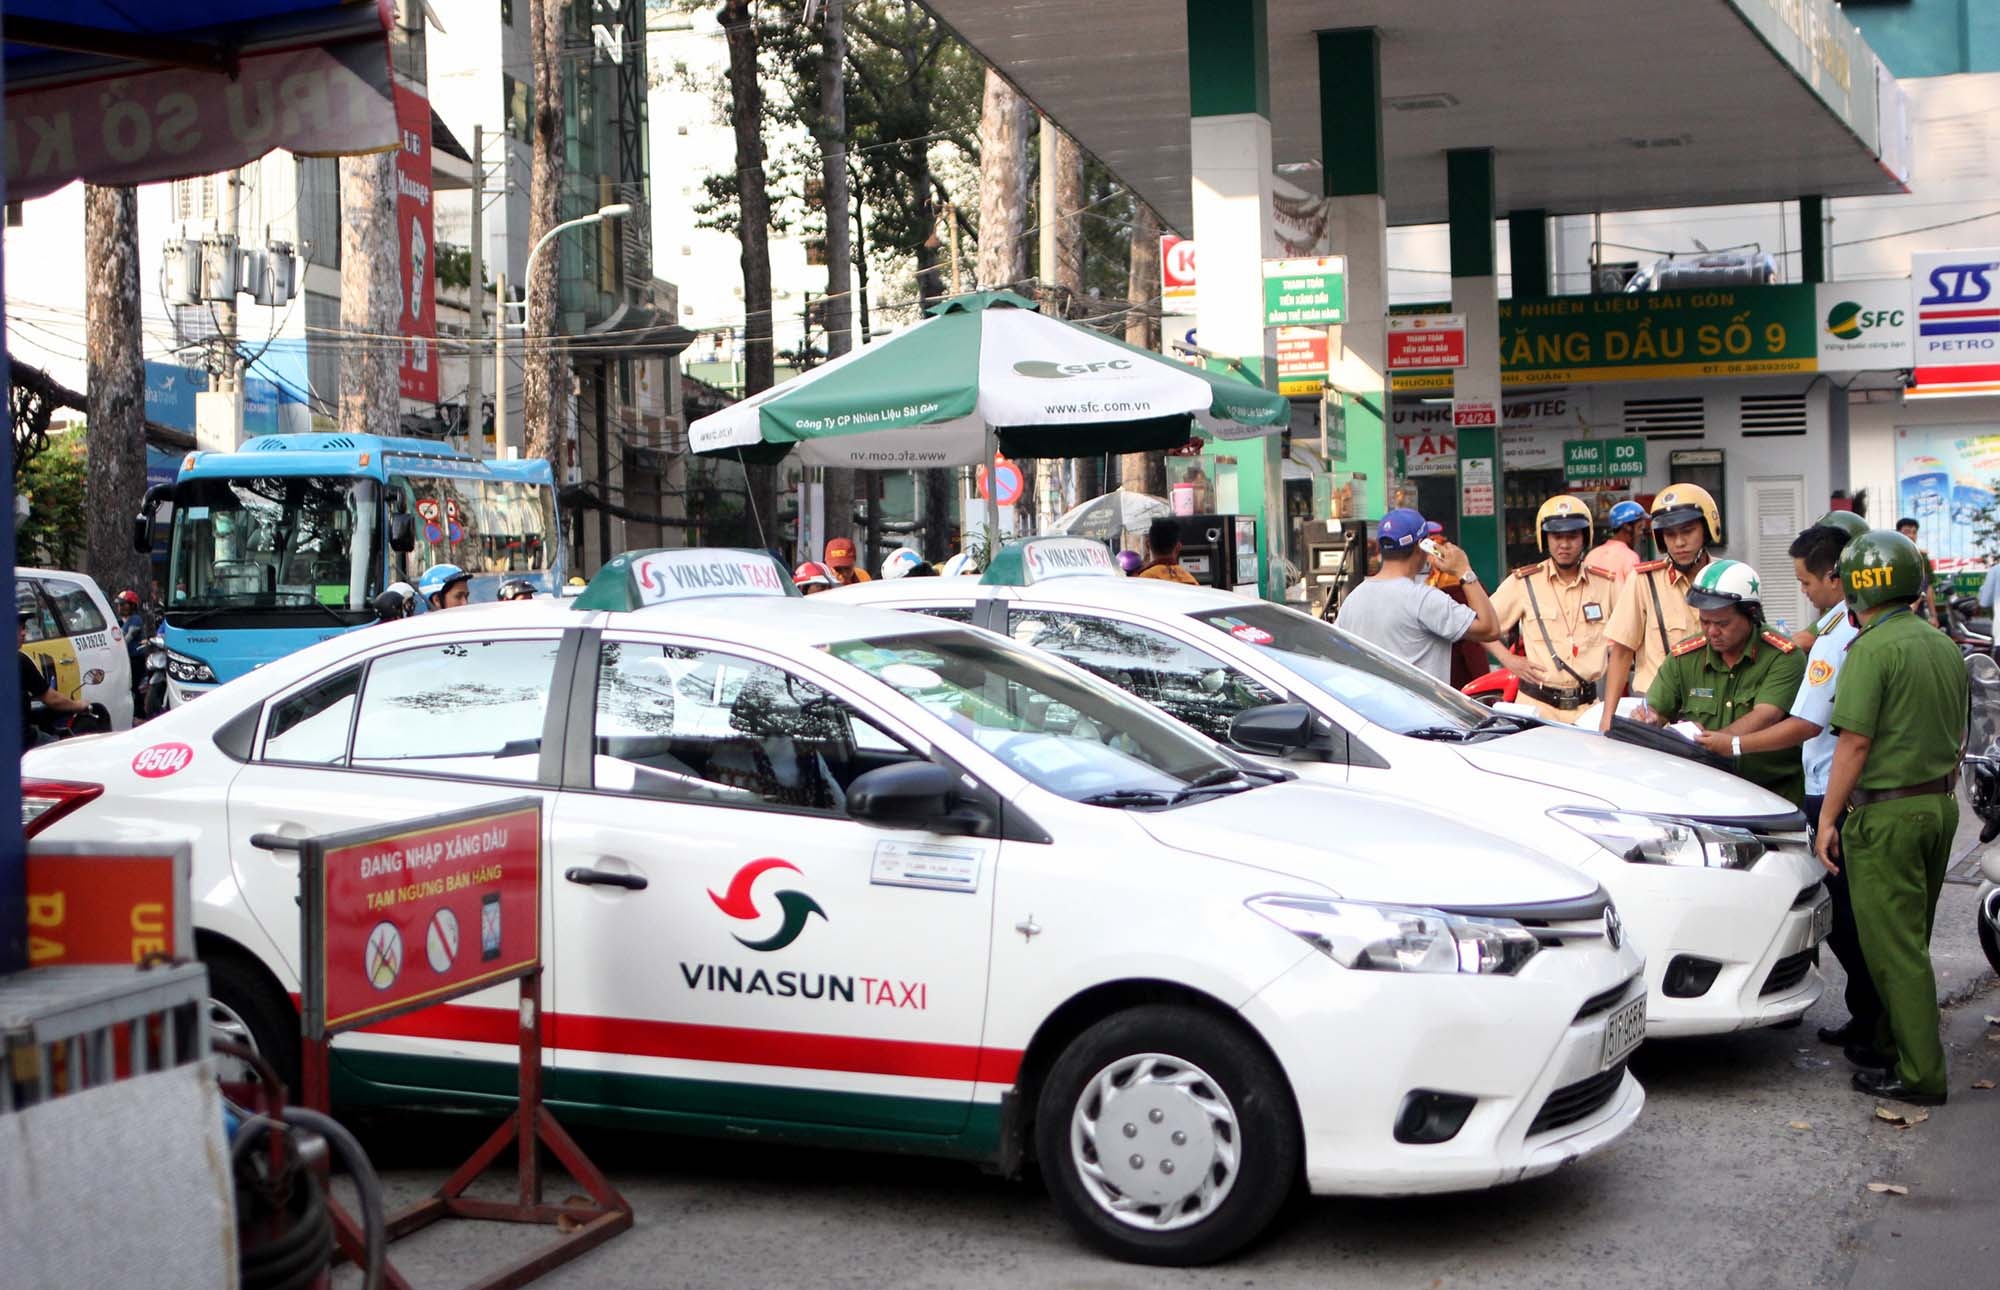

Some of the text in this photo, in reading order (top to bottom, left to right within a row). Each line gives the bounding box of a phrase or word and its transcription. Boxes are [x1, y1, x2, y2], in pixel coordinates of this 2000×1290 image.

[397, 168, 430, 207] Massage
[1919, 262, 1993, 306] STS
[1521, 300, 1585, 317] NHIÊN
[1594, 295, 1640, 315] LIỆU
[1648, 292, 1682, 310] SÀI
[1691, 291, 1735, 308] GÒN
[1860, 310, 1904, 328] SFC
[1605, 317, 1685, 361] DẦU
[1697, 310, 1753, 356] SỐ
[1764, 322, 1787, 353] 9
[1929, 338, 1994, 351] PETRO
[1066, 360, 1132, 374] SFC
[796, 419, 823, 430] Công
[824, 417, 835, 429] Ty
[837, 416, 851, 427] CP
[881, 407, 902, 421] Liệu
[903, 404, 918, 417] Sài
[1044, 401, 1151, 414] www.sfc.com.vn
[1459, 412, 1492, 425] 24/24
[1571, 446, 1598, 460] XĂNG
[1616, 446, 1635, 458] DO
[1851, 566, 1893, 590] CSTT
[135, 747, 189, 771] 9504
[360, 826, 508, 880] ĐANG NHẬP XĂNG DẦU
[366, 888, 396, 913] TẠM
[472, 863, 503, 884] HÀNG
